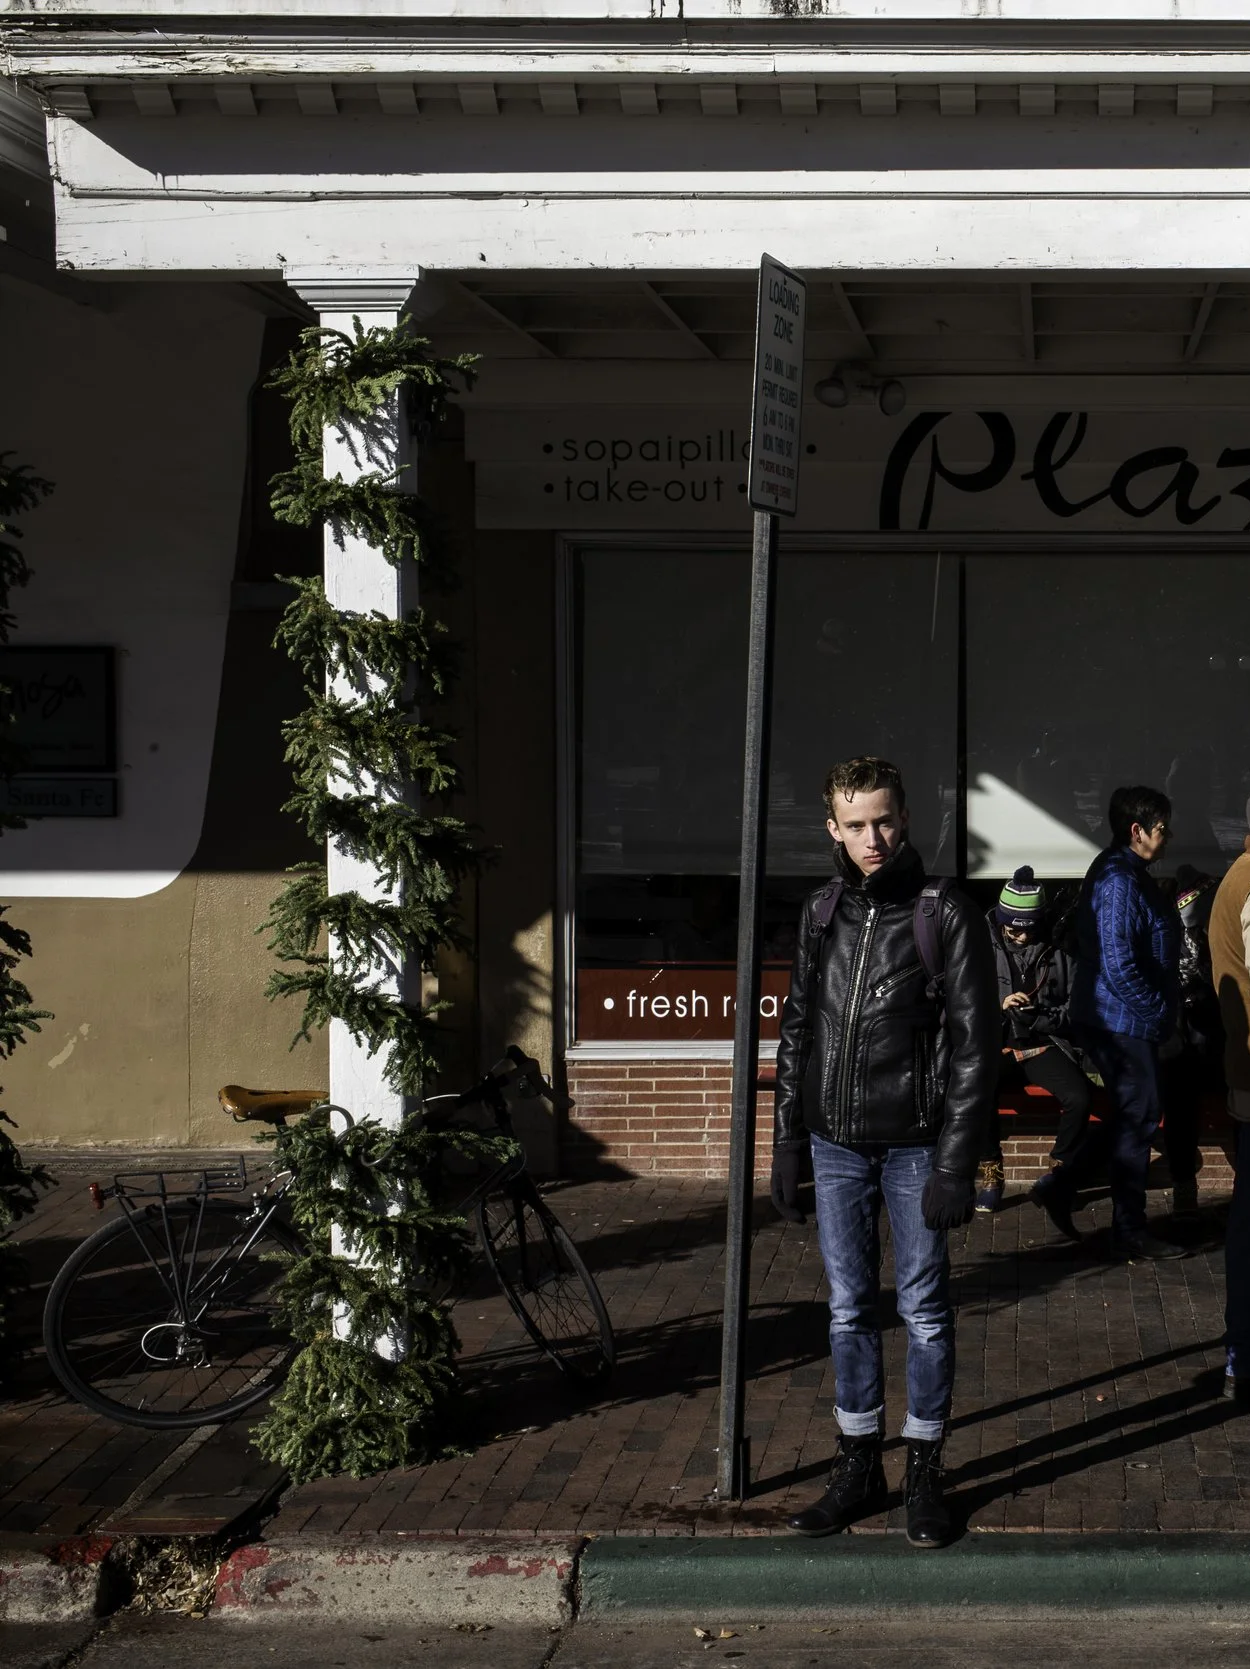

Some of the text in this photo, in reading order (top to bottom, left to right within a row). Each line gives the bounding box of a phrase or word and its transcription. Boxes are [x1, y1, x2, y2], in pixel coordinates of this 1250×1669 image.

[769, 278, 799, 316] LOADING
[774, 314, 793, 344] ZONE
[764, 353, 773, 371] 20
[786, 362, 798, 383] LIMIT
[762, 378, 798, 408] PERMIT REQUIRED
[762, 405, 768, 426] 6
[778, 411, 783, 430] TO
[565, 468, 724, 501] take-out
[8, 787, 105, 807] Santa Fe
[626, 989, 708, 1017] fresh
